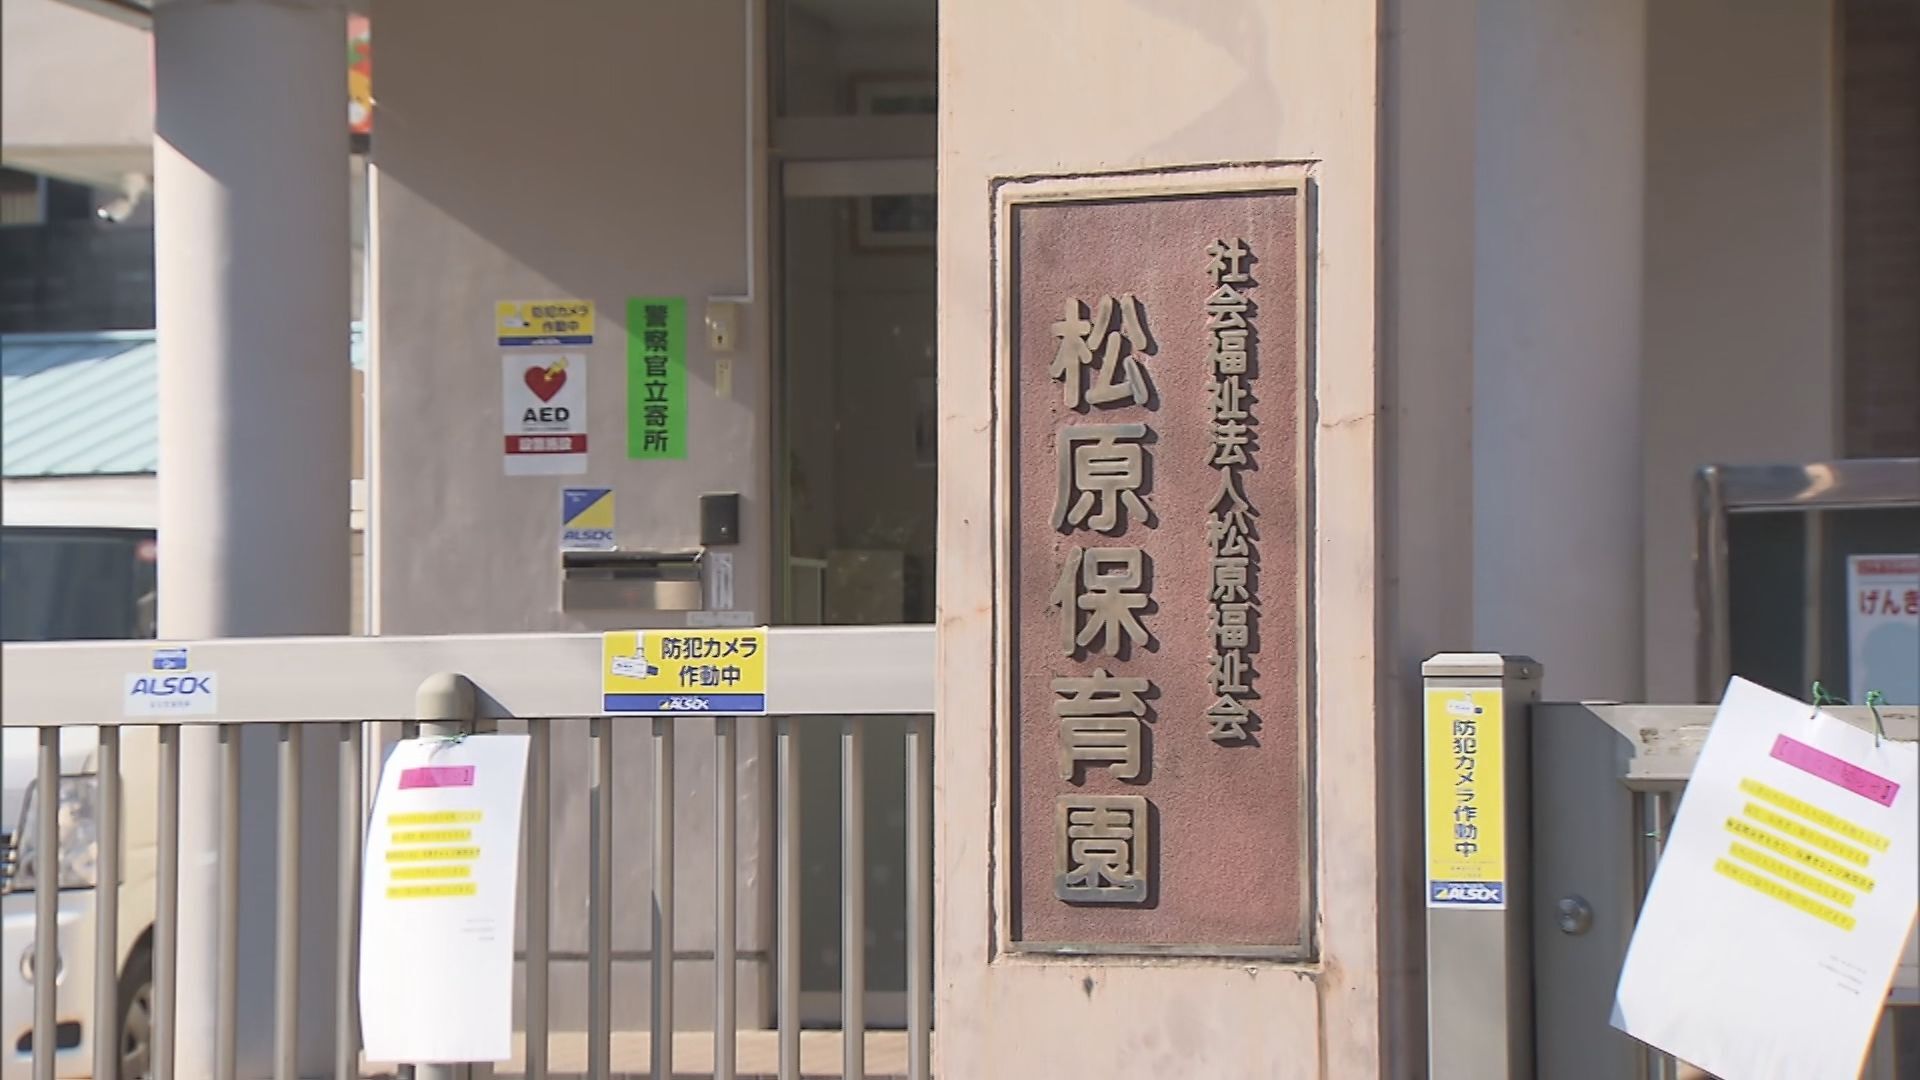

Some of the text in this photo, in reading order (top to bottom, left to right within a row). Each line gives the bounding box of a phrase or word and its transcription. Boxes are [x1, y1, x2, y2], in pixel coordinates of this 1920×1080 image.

[644, 304, 668, 452] 警察官立寄所
[523, 407, 570, 422] AED
[1206, 239, 1254, 742] 社会福祉法人松原福祉会
[1050, 294, 1151, 904] 松原保育園
[661, 636, 757, 660] 防犯カメラ
[130, 676, 211, 696] ALSOK
[679, 665, 741, 688] 作動中
[668, 697, 710, 710] ALSOK
[1452, 719, 1478, 858] 防犯カメラ作動中
[1449, 887, 1500, 902] ALSOK
